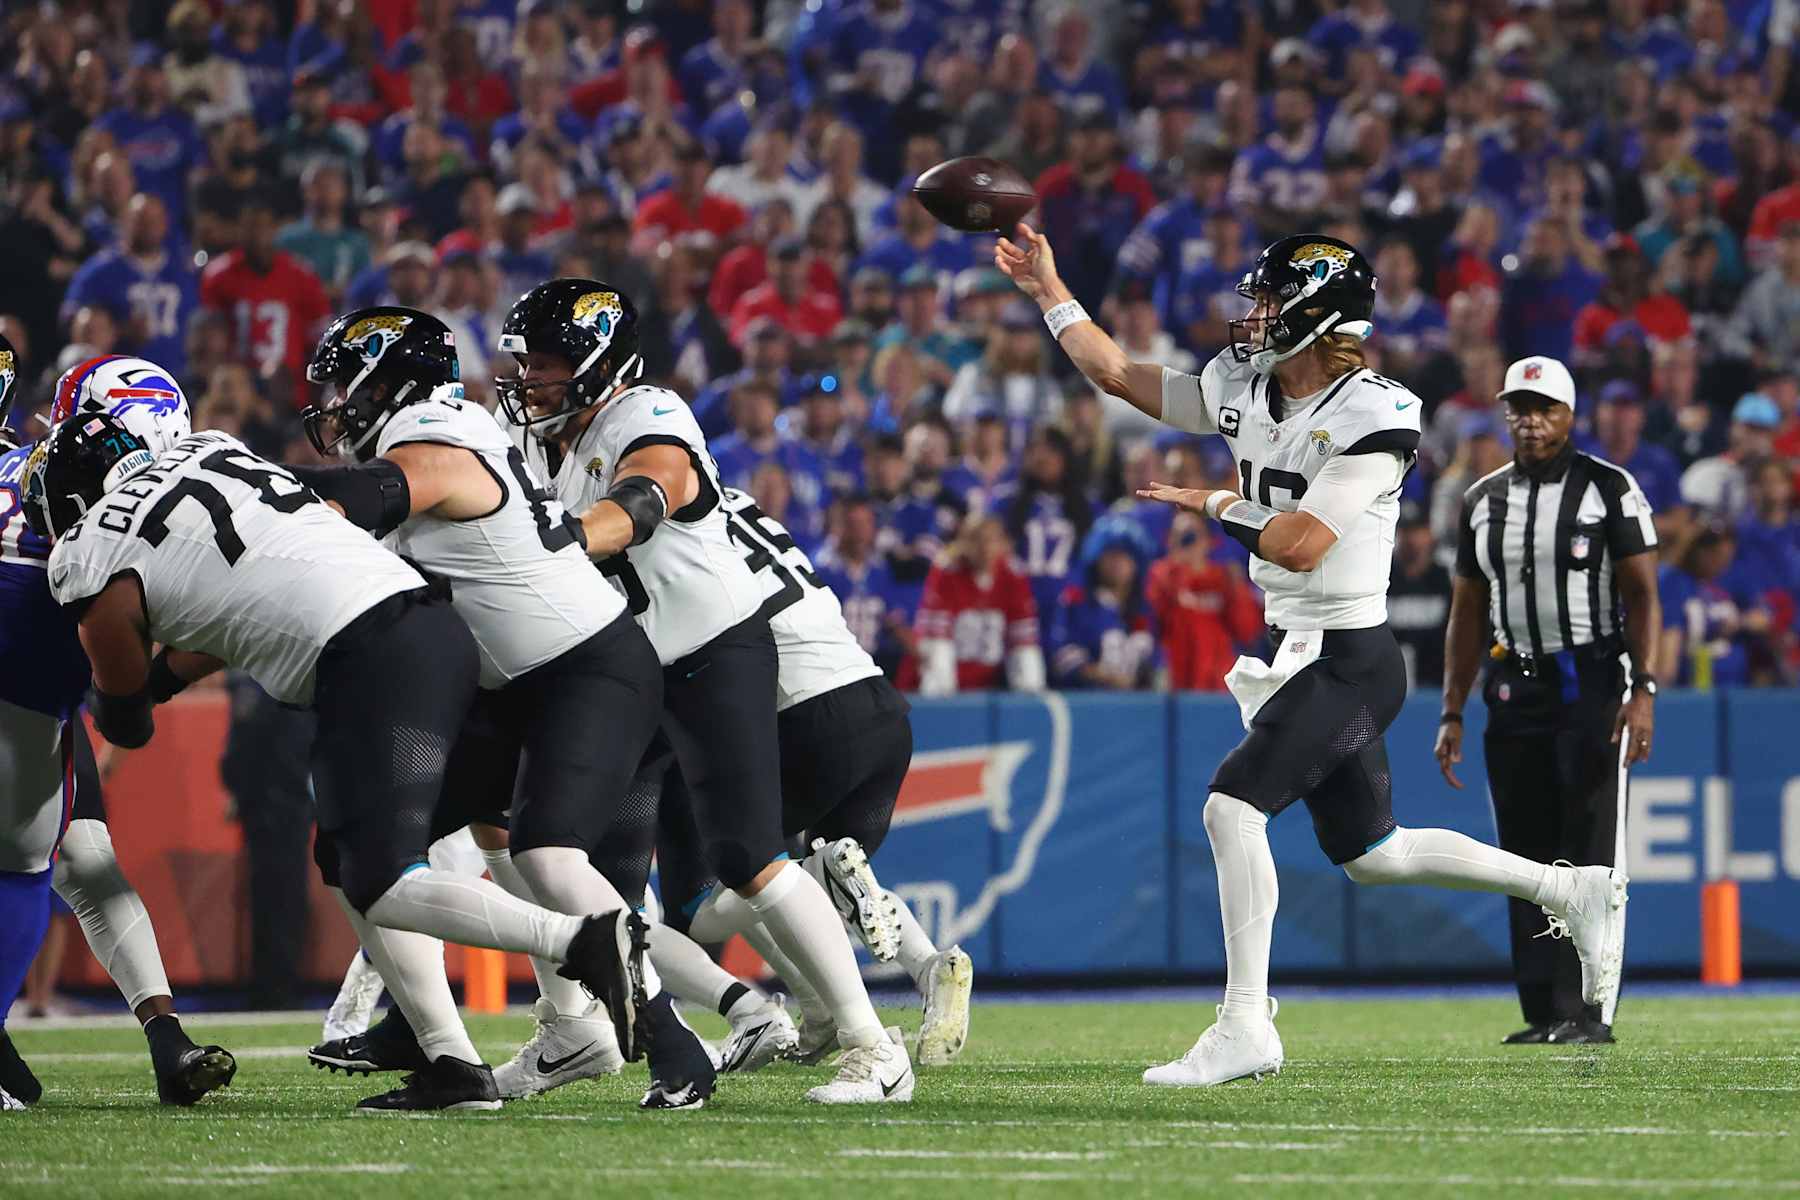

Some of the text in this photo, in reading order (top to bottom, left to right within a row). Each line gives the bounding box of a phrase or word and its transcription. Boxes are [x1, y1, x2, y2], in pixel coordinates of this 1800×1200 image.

[1218, 408, 1240, 431] C
[105, 432, 137, 456] 76
[1025, 520, 1075, 577] 17
